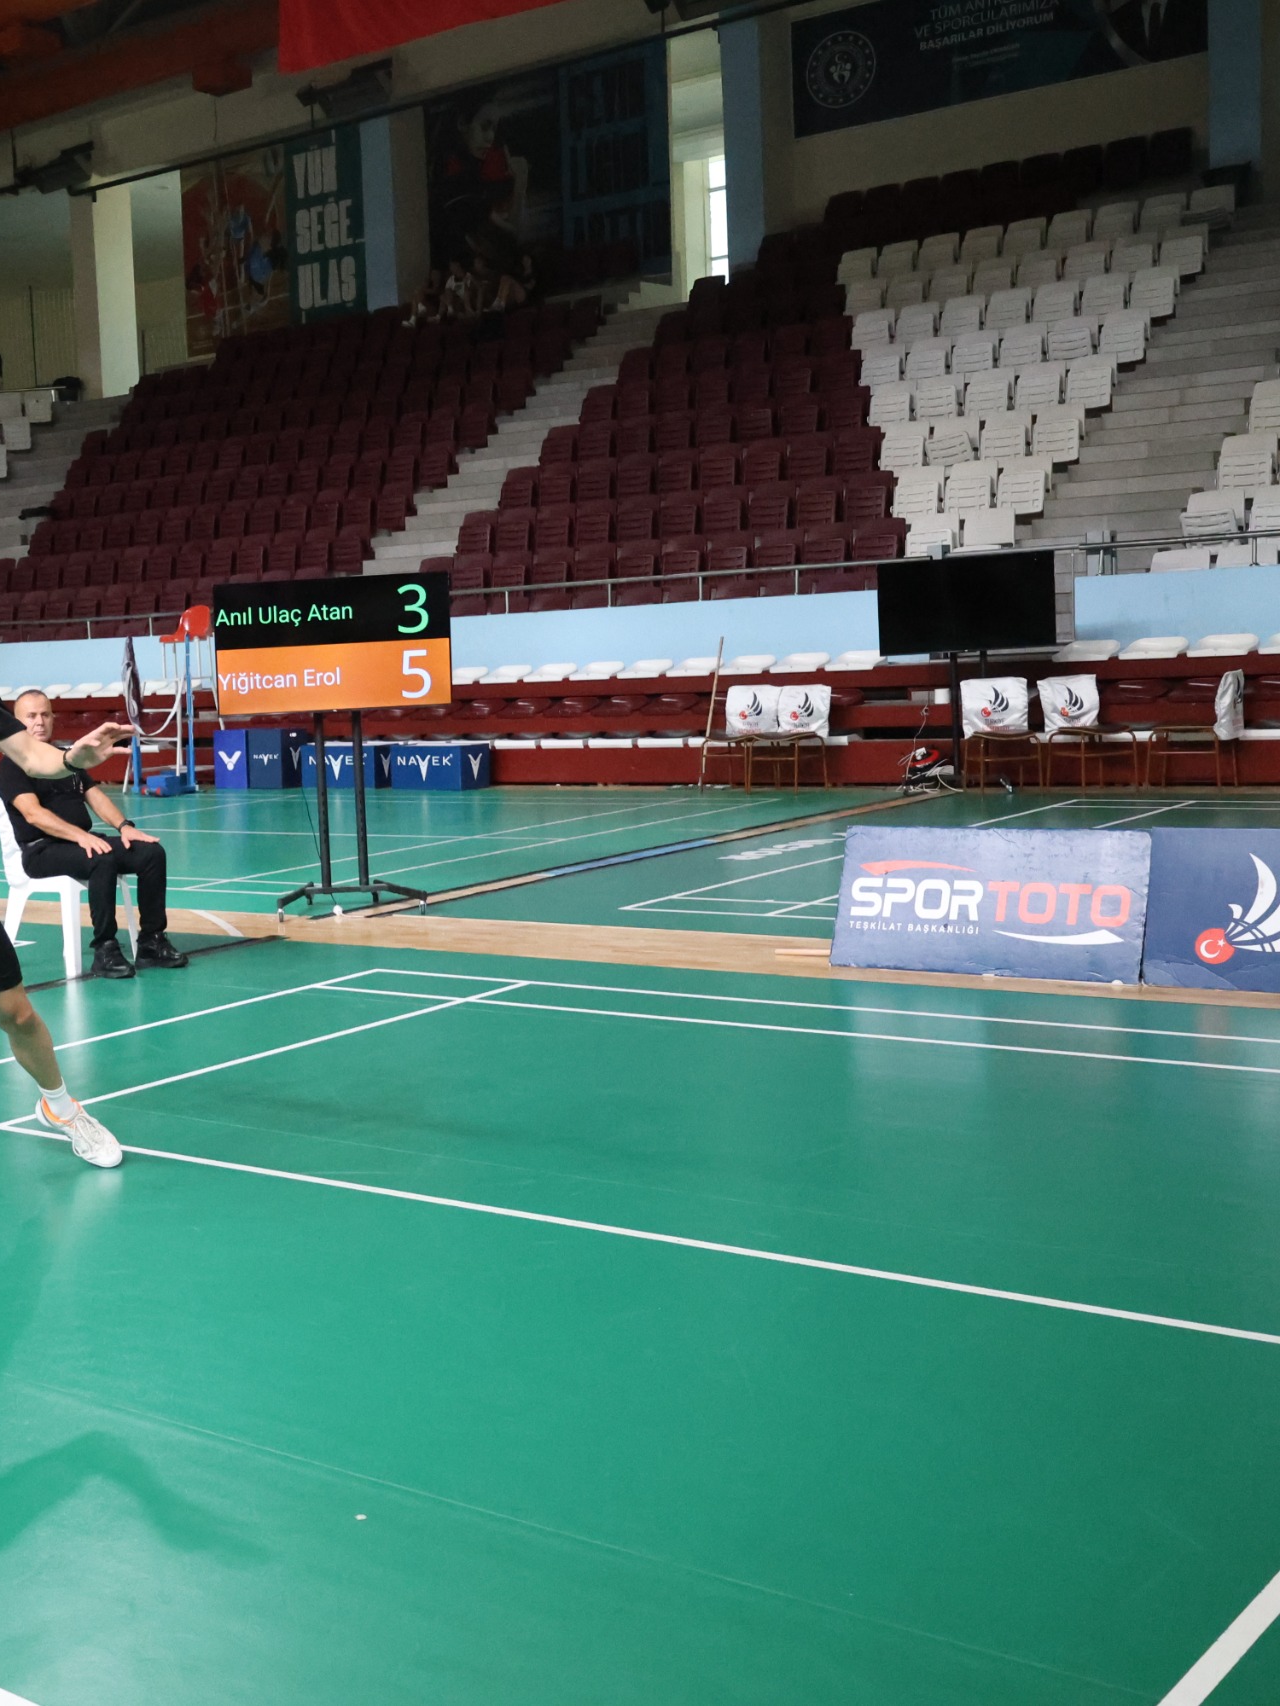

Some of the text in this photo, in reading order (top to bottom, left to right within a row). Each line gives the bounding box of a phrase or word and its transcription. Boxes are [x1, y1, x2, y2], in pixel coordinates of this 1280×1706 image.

[297, 256, 356, 308] ULAŞ
[215, 583, 429, 634] Anıl Ulaç Atan 3
[217, 649, 432, 699] Yiğitcan Erol 5
[397, 754, 451, 781] NAVEK
[849, 920, 979, 935] TEŞKİLAT BAŞKANLIĞI
